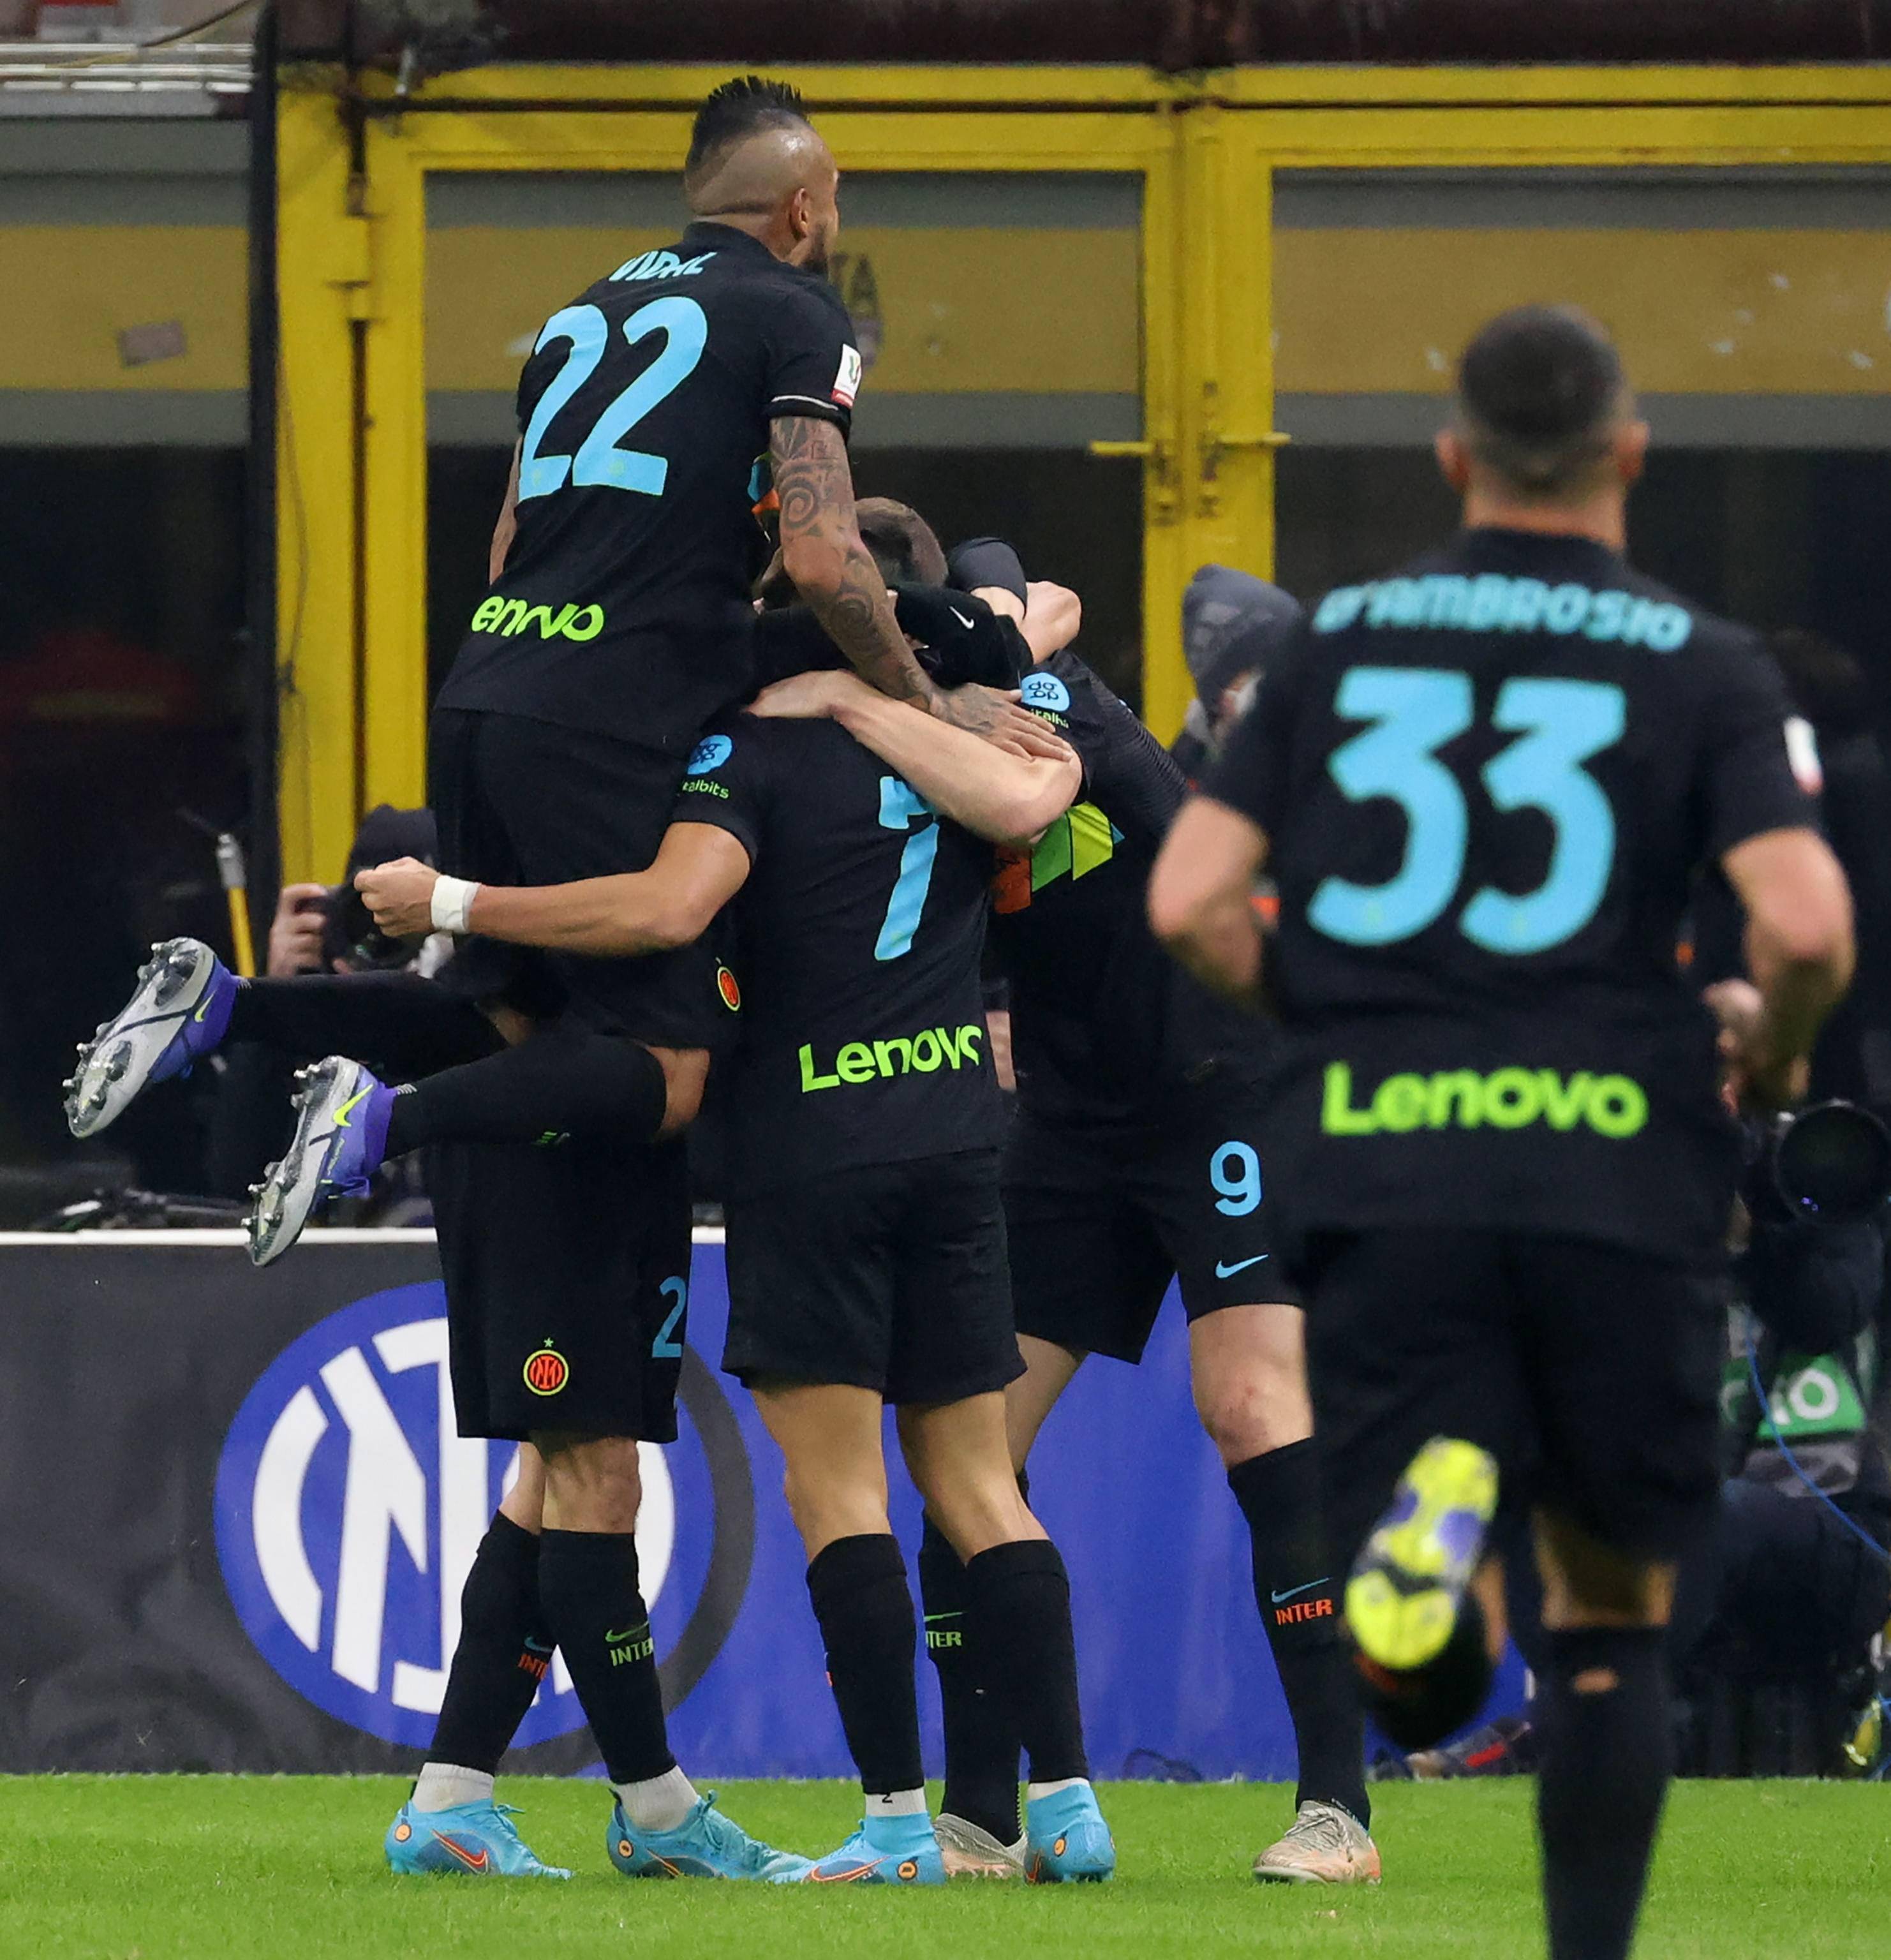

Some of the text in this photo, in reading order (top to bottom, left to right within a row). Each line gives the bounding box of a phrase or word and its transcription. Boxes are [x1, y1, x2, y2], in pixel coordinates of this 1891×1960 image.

[518, 296, 708, 501] 22
[1308, 665, 1626, 954] 33
[874, 776, 940, 961] 7
[1321, 1061, 1649, 1139] Lenovo
[1210, 1140, 1262, 1217] 9
[651, 1275, 687, 1358] 2
[925, 1630, 963, 1649] TER
[1276, 1598, 1333, 1626] INTER
